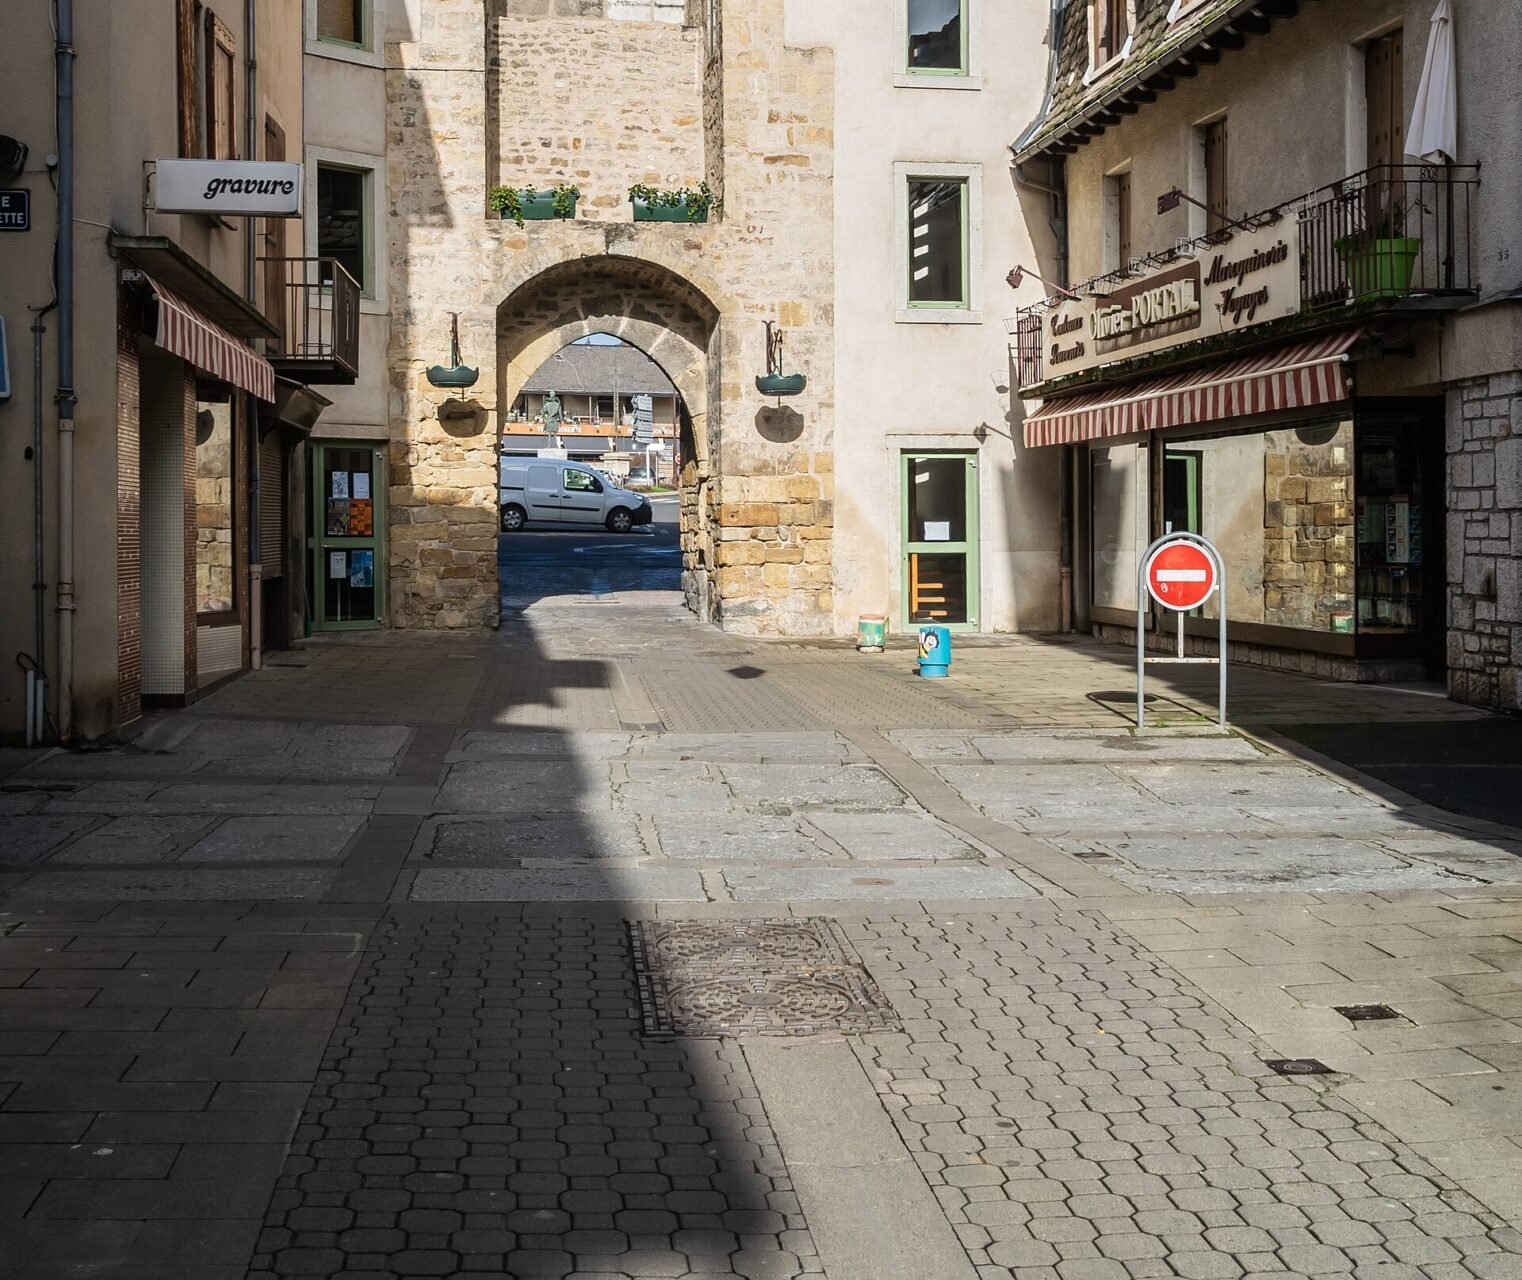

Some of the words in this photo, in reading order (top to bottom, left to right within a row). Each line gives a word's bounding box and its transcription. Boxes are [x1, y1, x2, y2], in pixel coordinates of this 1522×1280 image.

[203, 178, 294, 200] gravure
[1204, 239, 1288, 286] Maroquinerie
[1089, 305, 1132, 340] Olivier
[1131, 278, 1199, 329] PORTAL
[1220, 285, 1269, 325] Voyages
[1051, 314, 1083, 337] Cadeaux
[1049, 341, 1084, 366] Souvenirs
